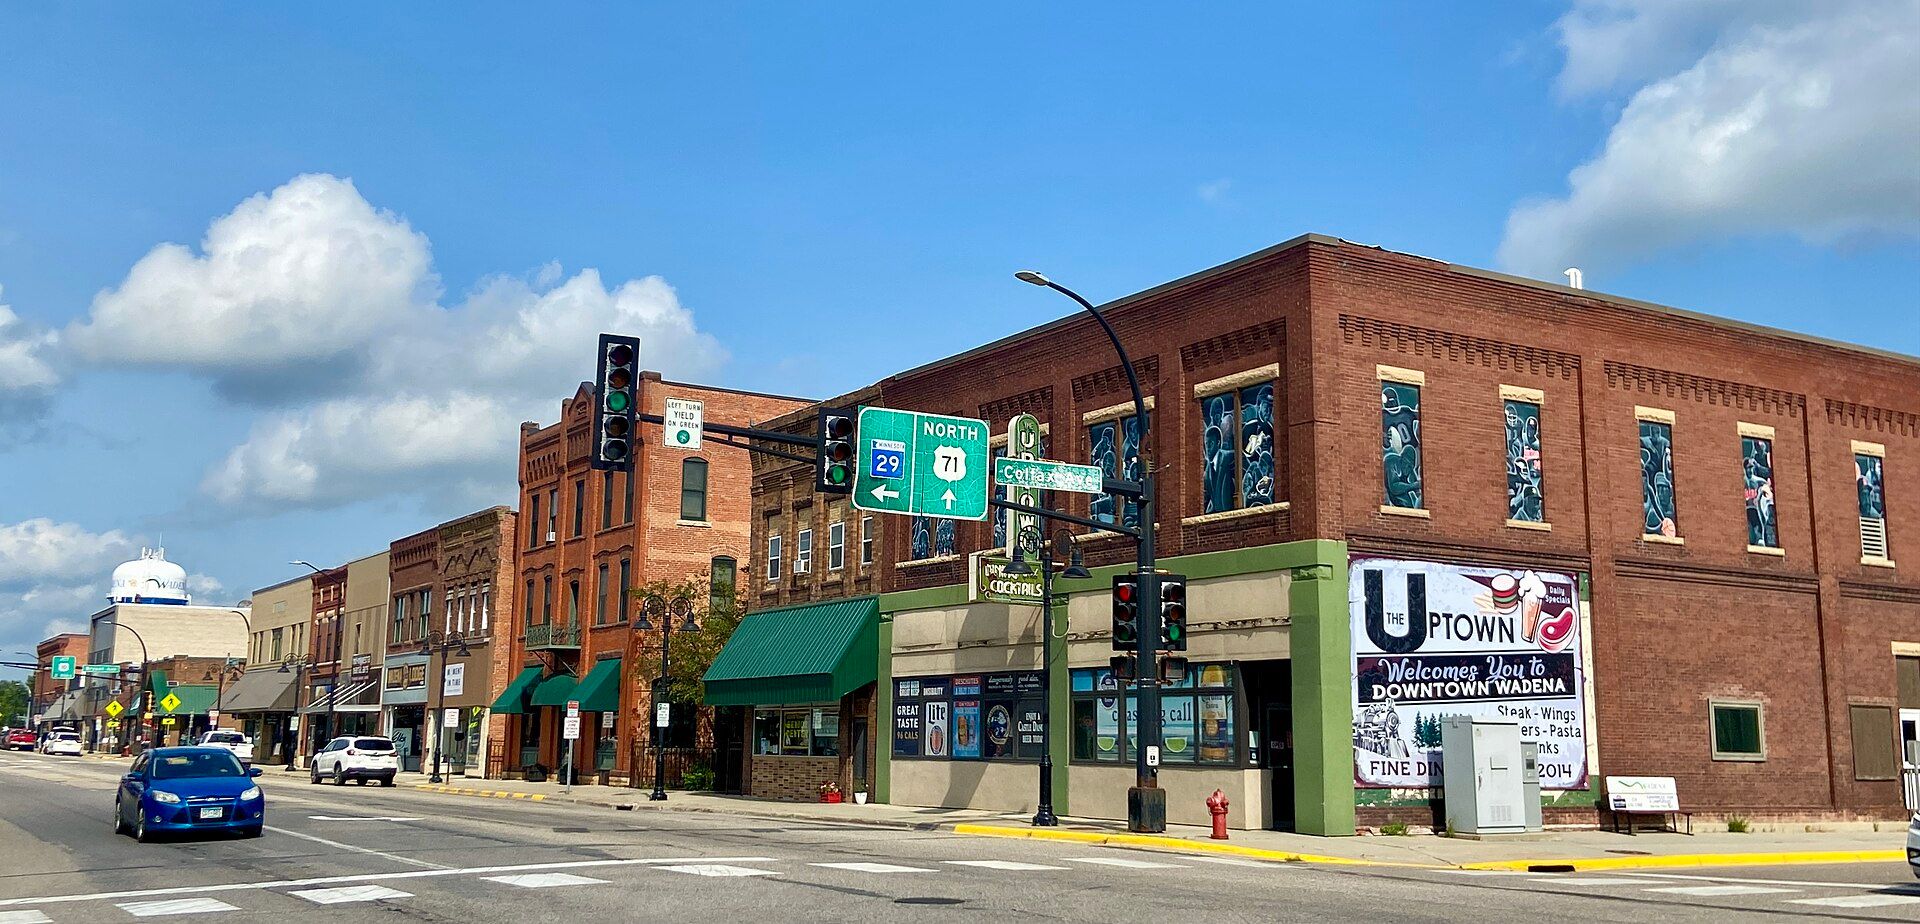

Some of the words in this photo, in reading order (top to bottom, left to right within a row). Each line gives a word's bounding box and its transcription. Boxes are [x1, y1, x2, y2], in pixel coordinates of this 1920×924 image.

[667, 401, 681, 409] LEFT
[685, 403, 701, 411] TURN
[673, 410, 695, 421] YIELD
[680, 421, 699, 429] GREEN
[923, 421, 978, 440] NORTH
[876, 454, 900, 473] 29
[941, 455, 958, 473] 71
[1003, 465, 1055, 484] Colfax
[1064, 473, 1093, 487] Ave
[989, 579, 1044, 597] COCKTAILS
[1549, 585, 1565, 596] Daily
[1545, 595, 1571, 604] Specials
[1386, 612, 1404, 625] THE
[1378, 656, 1479, 682] Welcomes
[1485, 656, 1525, 683] You
[1528, 656, 1546, 677] to
[1372, 680, 1490, 700] DOWNTOWN
[1493, 677, 1566, 694] WADENA
[897, 705, 919, 716] GREAT
[928, 704, 946, 724] Lite
[1169, 702, 1191, 722] call
[1541, 706, 1576, 724] Wings
[897, 718, 919, 729] TASTE
[1549, 724, 1582, 738] Pasta
[904, 731, 919, 740] CALS
[1370, 760, 1411, 776] FINE
[1538, 763, 1572, 779] 2014
